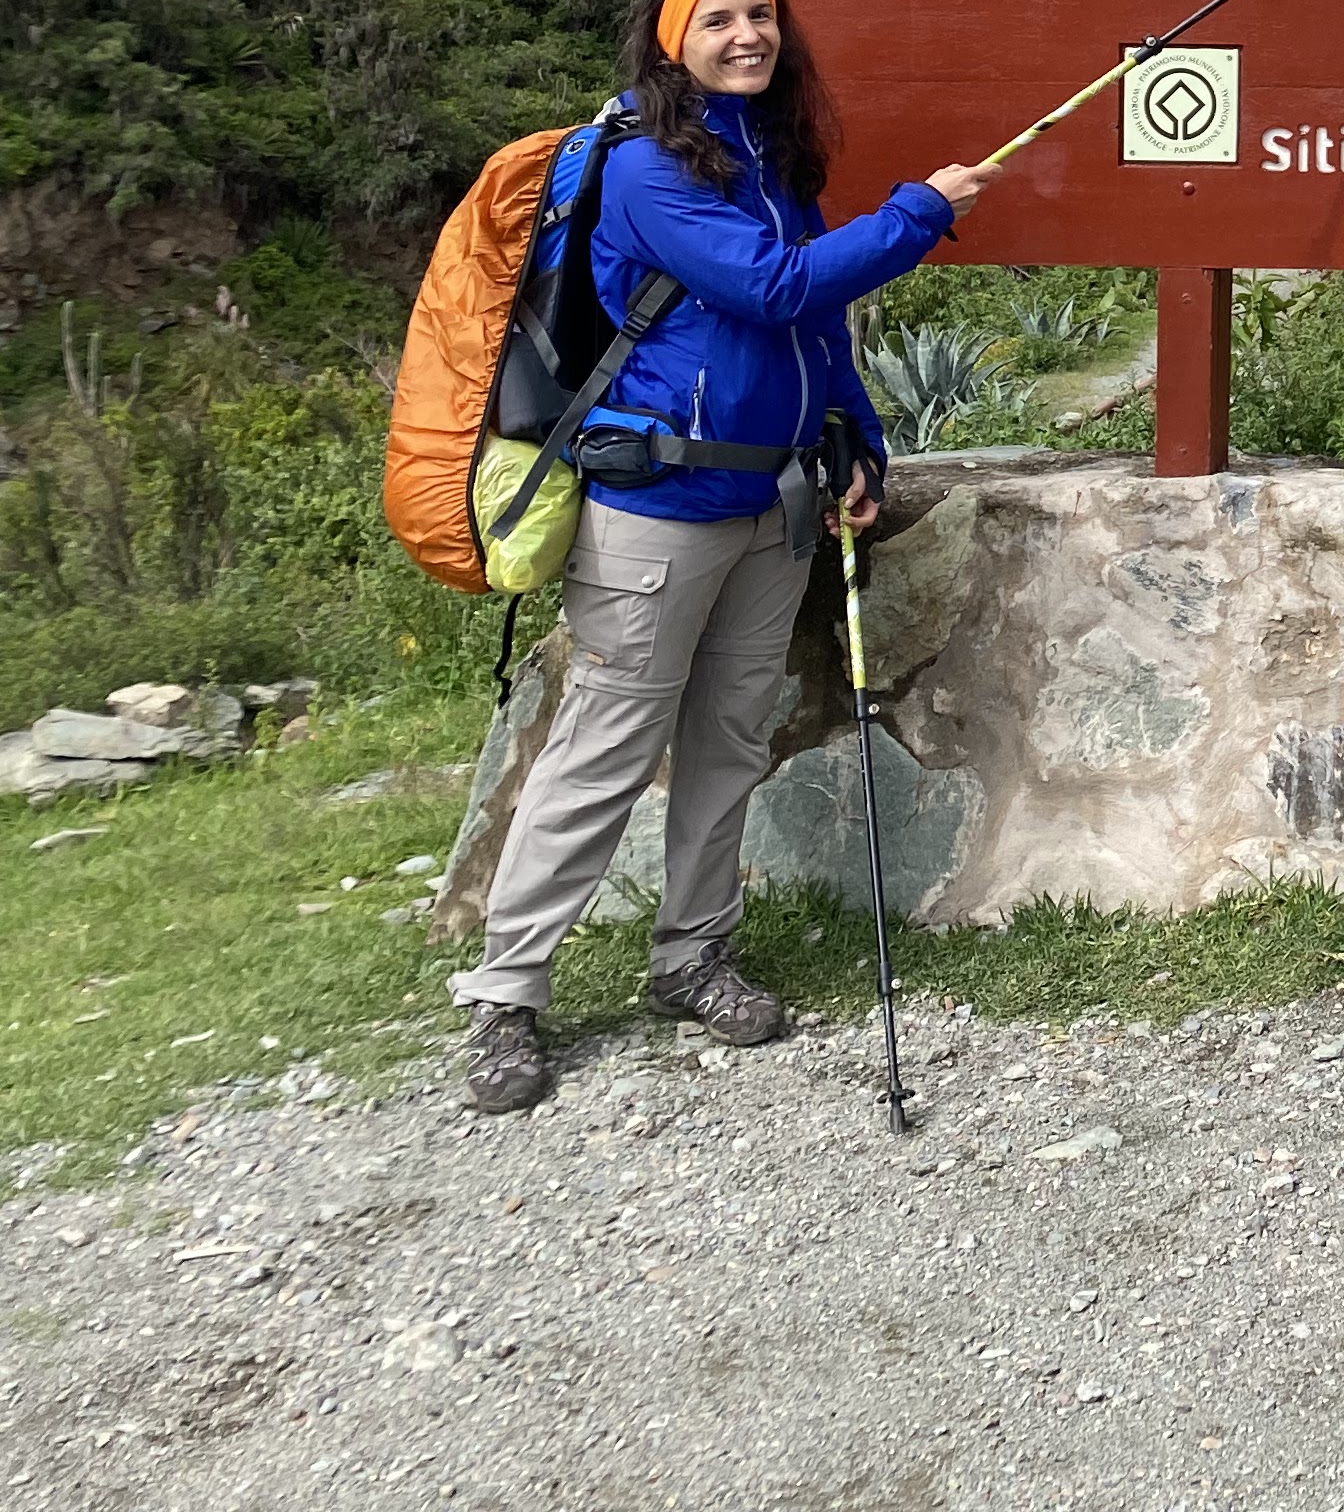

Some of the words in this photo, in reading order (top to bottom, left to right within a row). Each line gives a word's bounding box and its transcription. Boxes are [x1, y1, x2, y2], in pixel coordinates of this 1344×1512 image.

[1140, 55, 1186, 82] PATRIMONIO
[1188, 56, 1222, 83] MUNDIAL
[1131, 88, 1141, 119] WORLD
[1135, 121, 1168, 151] HERITAGE
[1174, 130, 1221, 154] PATRIMOINE
[1218, 89, 1231, 129] MONDIAL
